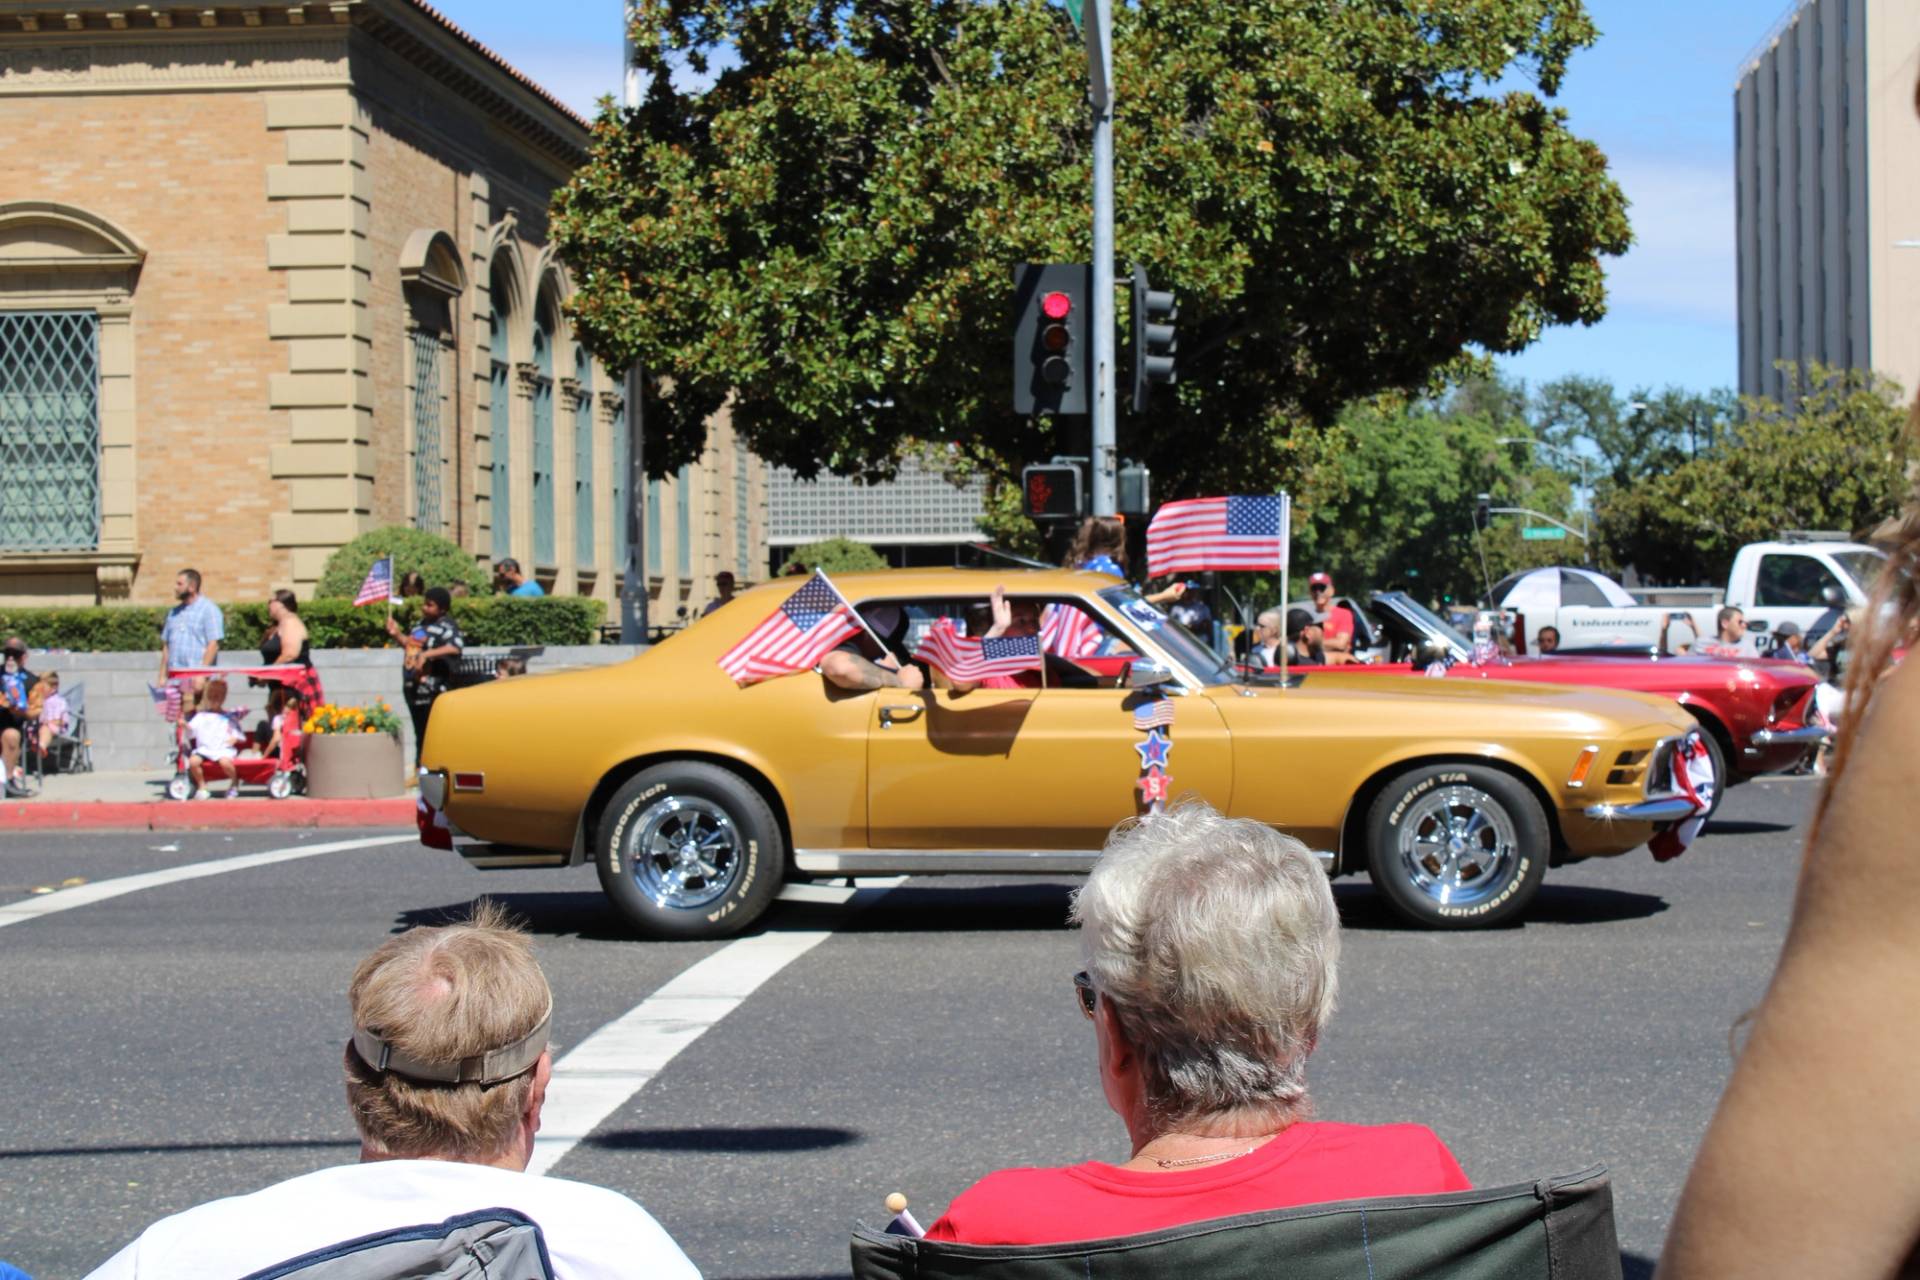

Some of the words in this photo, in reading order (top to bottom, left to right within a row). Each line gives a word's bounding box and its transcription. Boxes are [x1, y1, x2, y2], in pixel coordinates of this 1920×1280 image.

[1389, 777, 1435, 826] Radial
[1438, 772, 1469, 784] T/A
[609, 783, 668, 874] BFGoodrich
[738, 840, 758, 898] Radial
[1437, 857, 1531, 917] BFGoodrich
[706, 900, 738, 923] T/A
